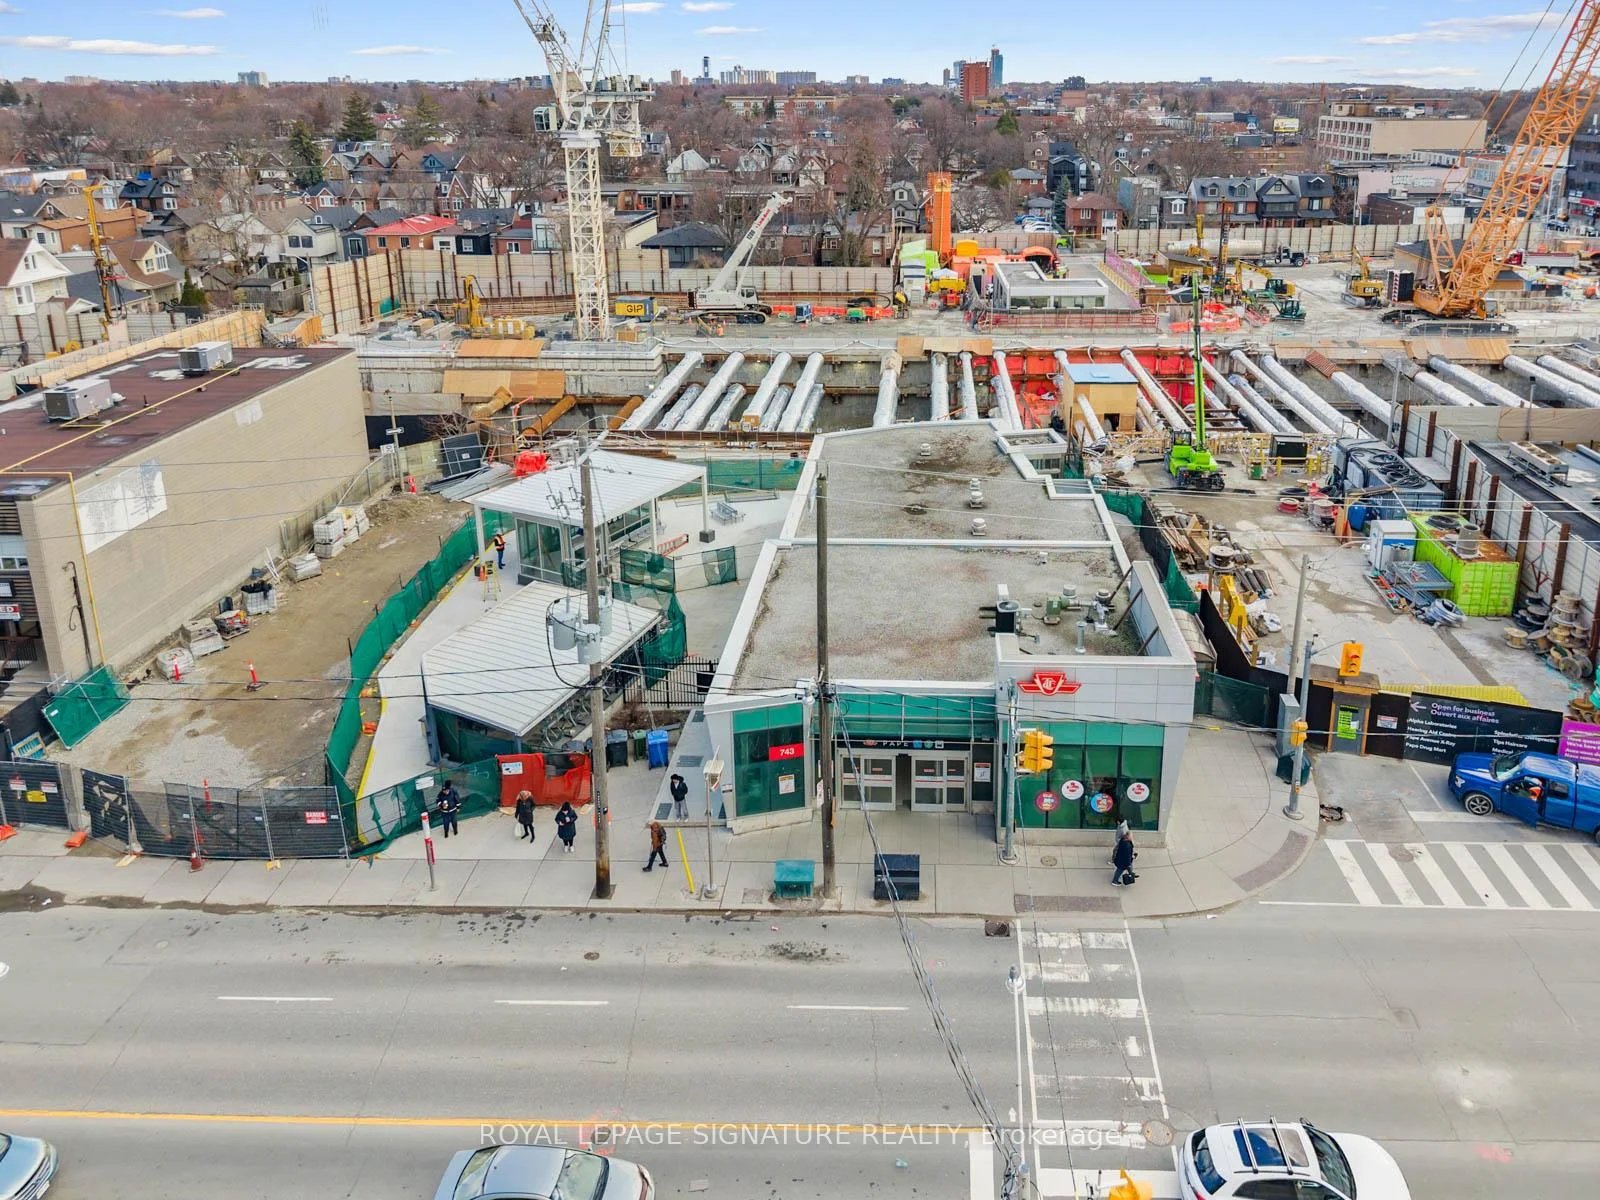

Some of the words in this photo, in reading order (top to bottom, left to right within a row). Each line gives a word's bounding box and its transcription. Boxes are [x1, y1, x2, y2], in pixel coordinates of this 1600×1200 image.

[626, 304, 643, 313] GIP
[1431, 702, 1452, 711] Open
[1452, 705, 1463, 713] for
[1464, 706, 1495, 717] business
[1431, 709, 1456, 718] Ouvert
[1471, 714, 1499, 724] affaires
[779, 747, 795, 756] 743
